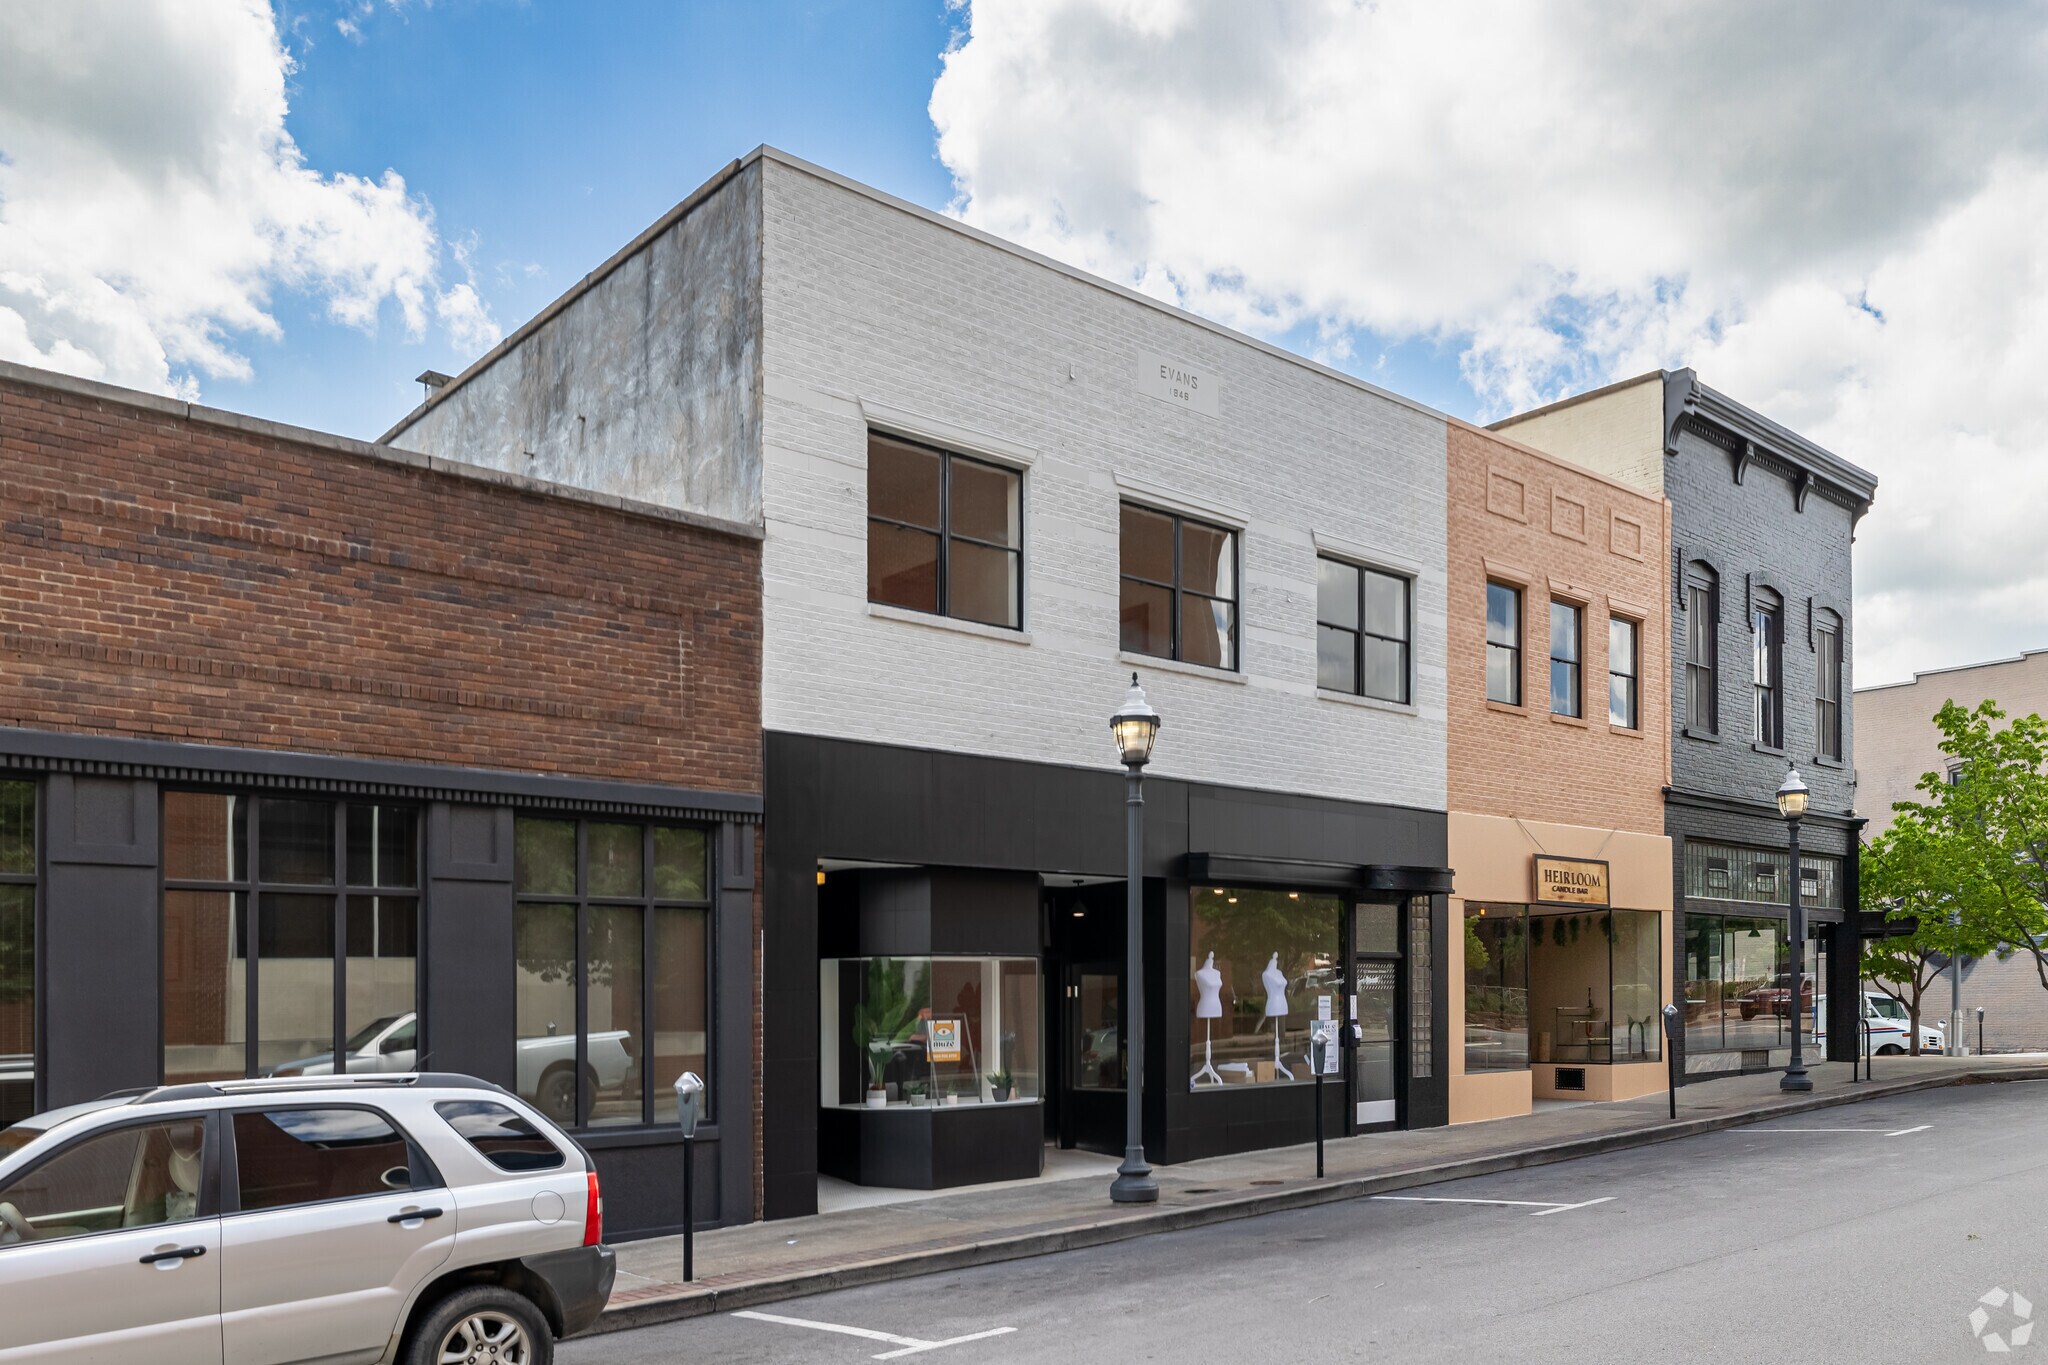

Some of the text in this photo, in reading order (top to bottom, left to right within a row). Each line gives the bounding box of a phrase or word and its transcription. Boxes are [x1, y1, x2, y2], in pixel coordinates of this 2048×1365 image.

[1160, 364, 1198, 390] EVANS
[1544, 869, 1601, 887] HEIRLOOM
[1551, 885, 1589, 895] CANDLE BAR
